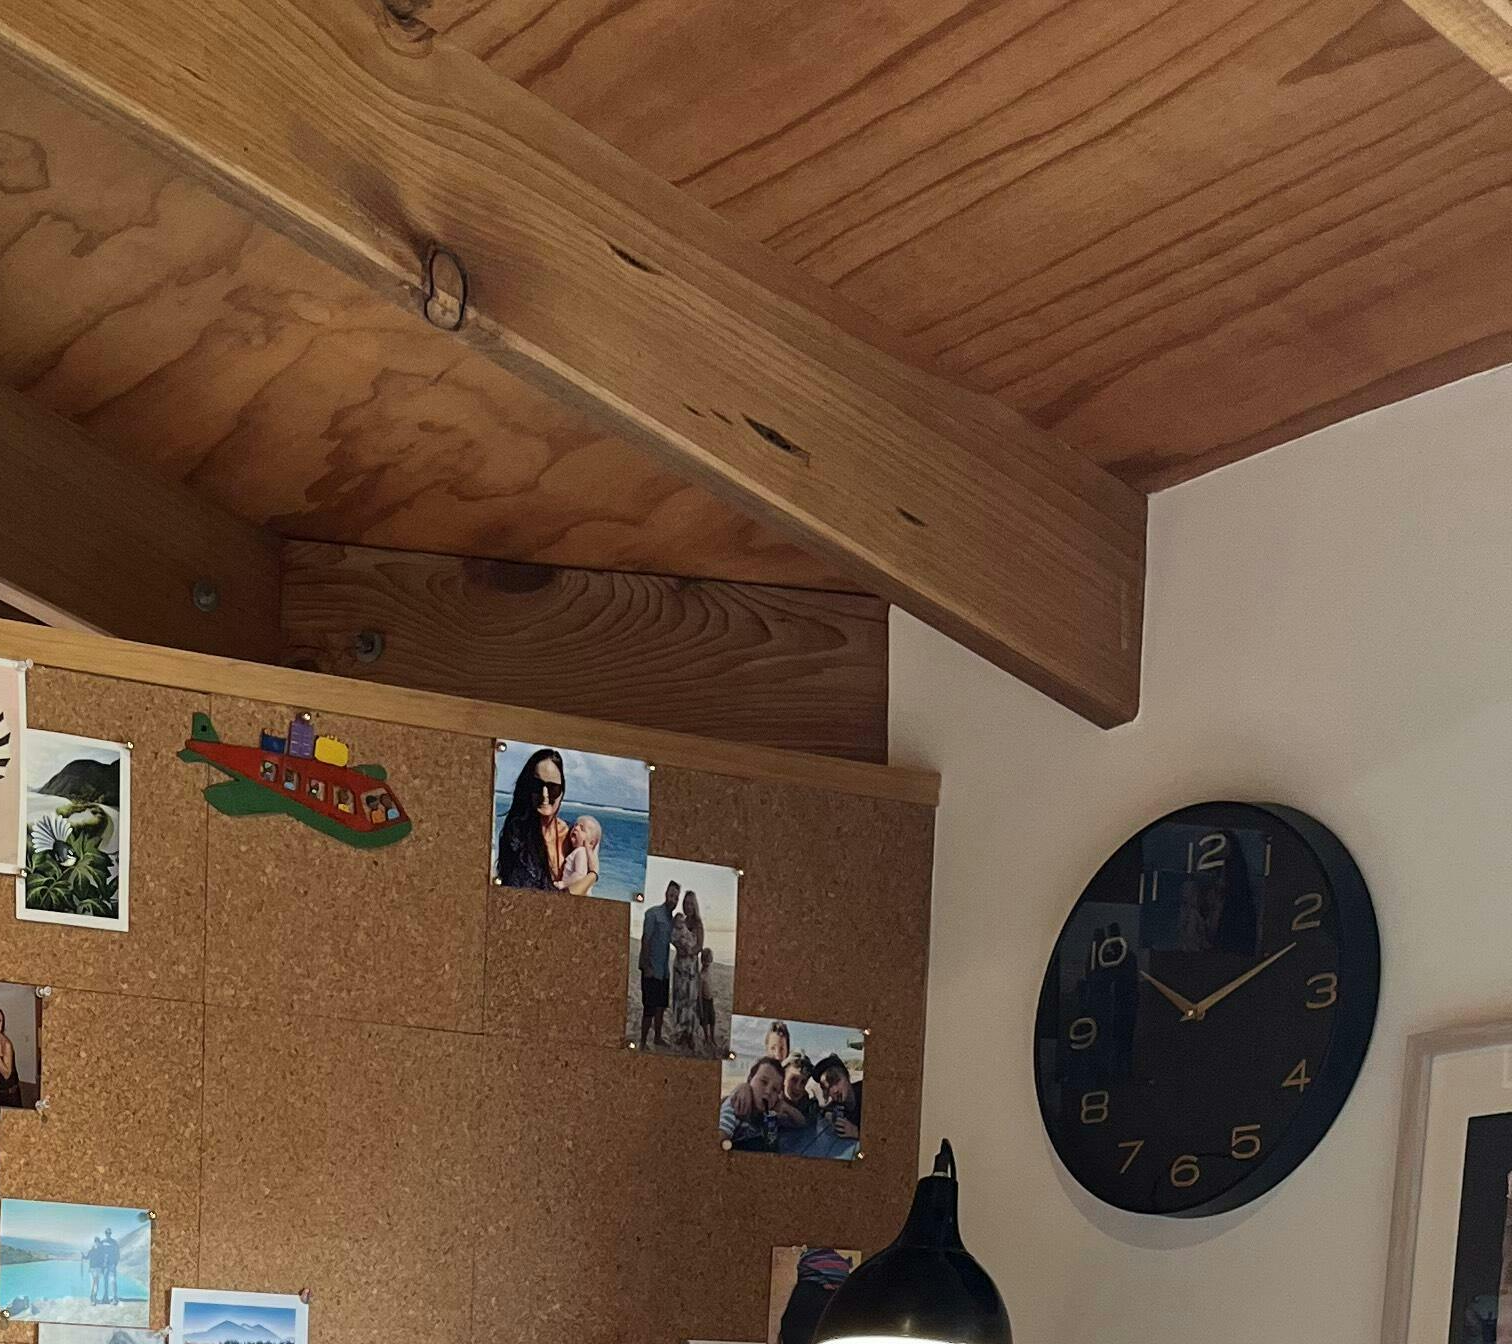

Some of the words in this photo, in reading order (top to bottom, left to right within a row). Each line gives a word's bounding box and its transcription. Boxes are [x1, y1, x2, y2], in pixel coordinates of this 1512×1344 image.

[1187, 833, 1227, 874] 12
[1139, 870, 1159, 904] 11
[1291, 893, 1323, 931] 2
[1089, 936, 1128, 971] 10
[1305, 972, 1338, 1009] 3
[1069, 1017, 1098, 1050] 9
[1281, 1058, 1311, 1093] 4
[1080, 1090, 1109, 1124] 8
[1118, 1139, 1144, 1175] 7
[1231, 1124, 1261, 1160] 5
[1170, 1154, 1201, 1188] 6
